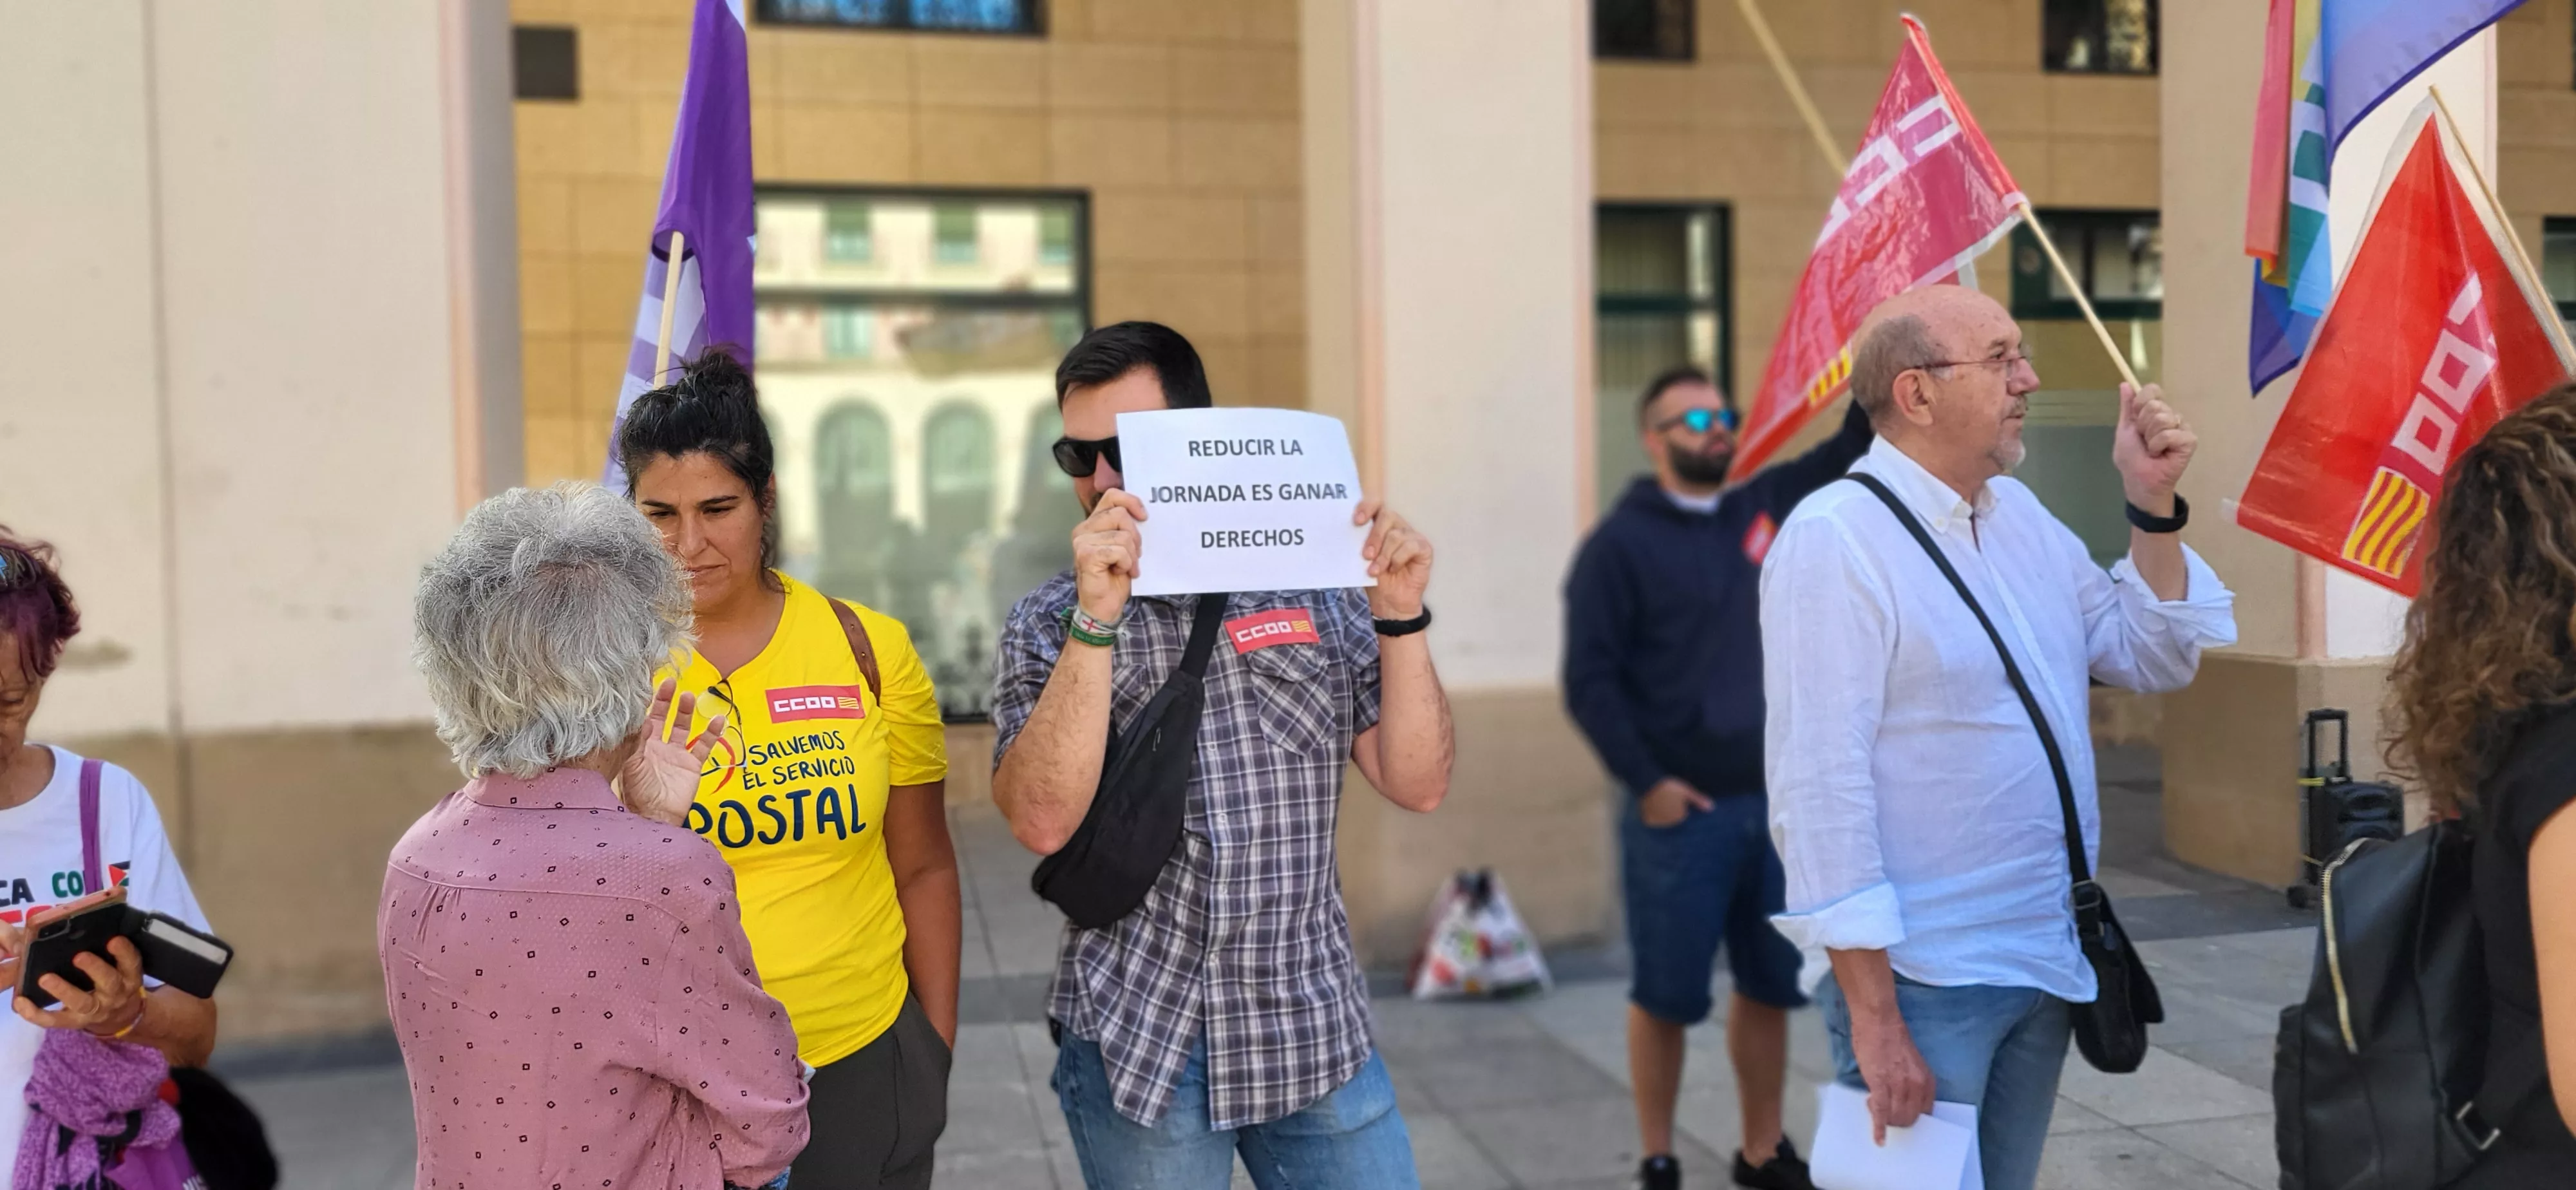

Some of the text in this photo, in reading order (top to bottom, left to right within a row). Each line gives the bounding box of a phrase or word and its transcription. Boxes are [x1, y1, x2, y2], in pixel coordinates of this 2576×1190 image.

[1188, 439, 1303, 457] REDUCIR LA
[1149, 483, 1348, 504] JORNADA ES GANAR
[1201, 529, 1304, 549] DERECHOS
[1235, 621, 1293, 643] CCOO
[773, 696, 836, 713] CCOO
[748, 730, 845, 766] SALVEMOS
[743, 756, 855, 791] EL SERVICIO
[681, 783, 867, 849] POSTAL
[52, 870, 85, 898] CO
